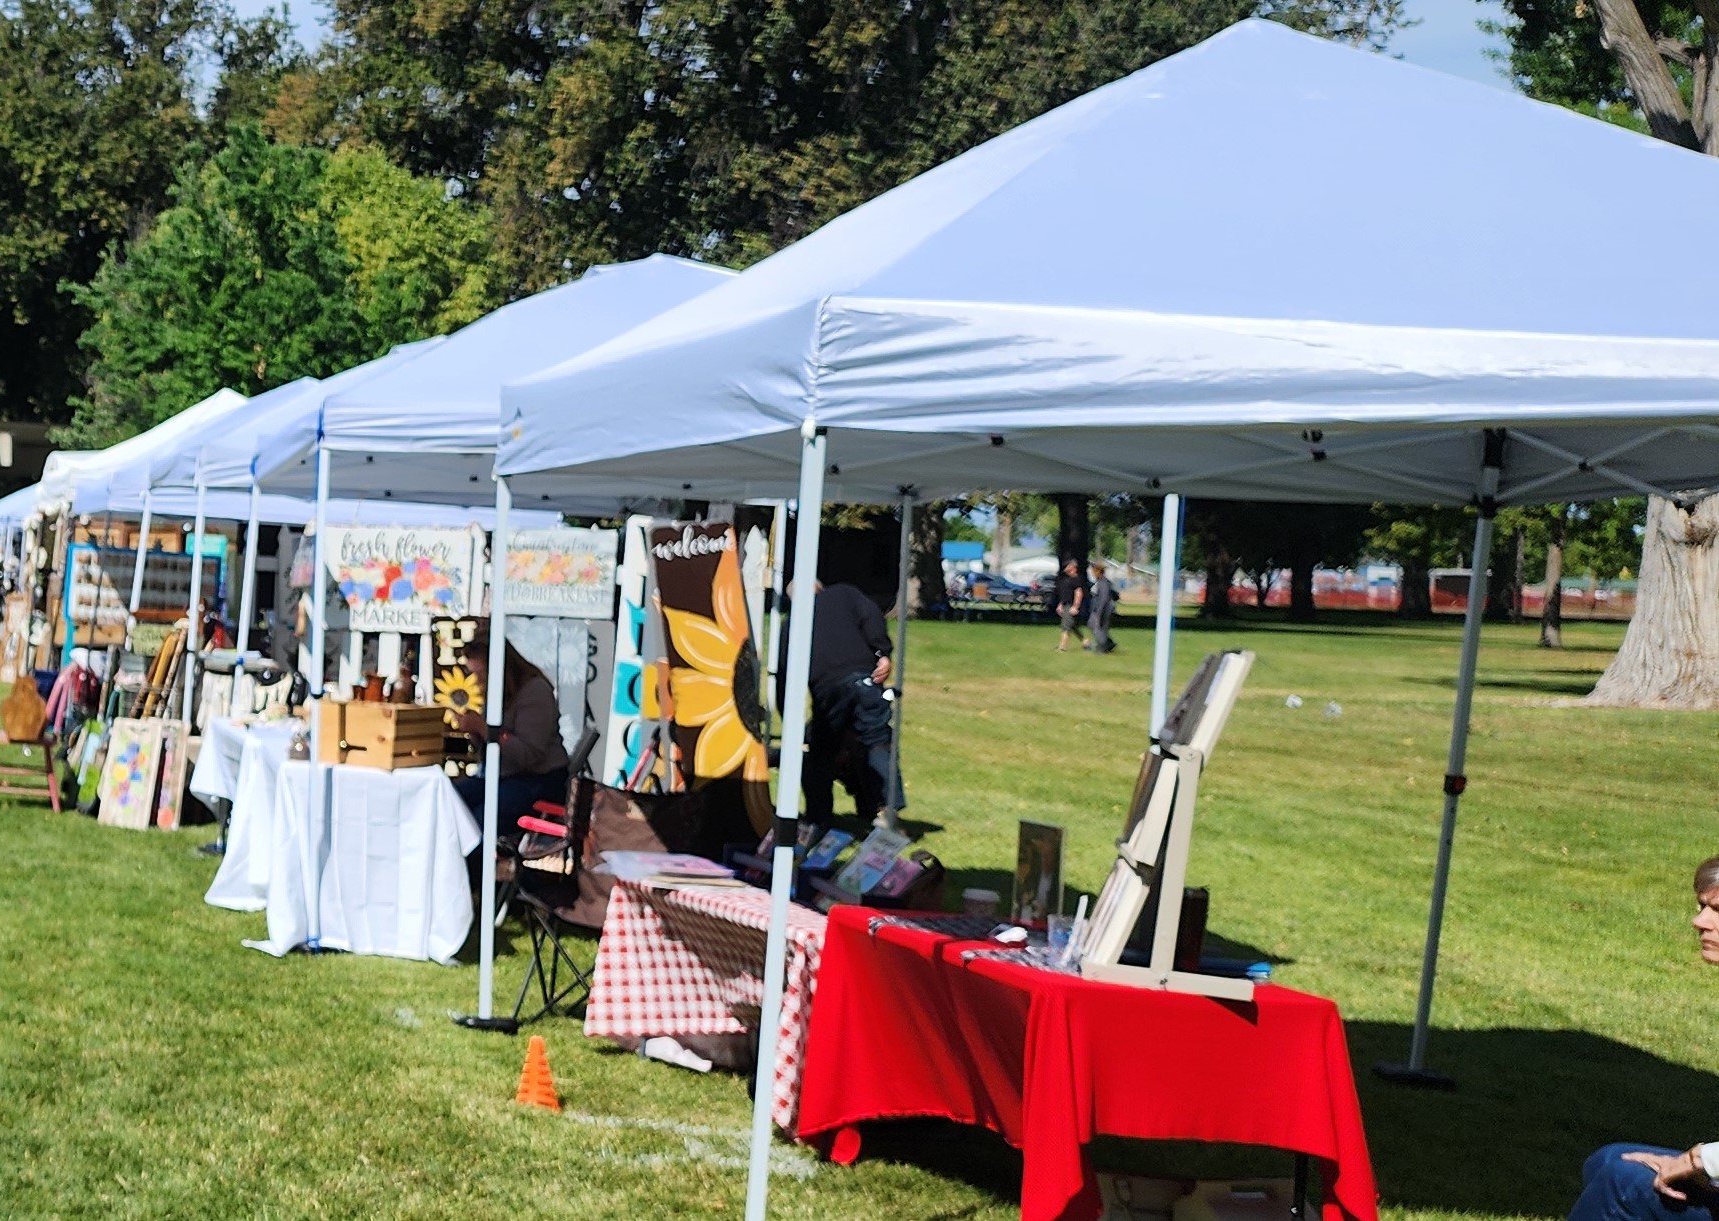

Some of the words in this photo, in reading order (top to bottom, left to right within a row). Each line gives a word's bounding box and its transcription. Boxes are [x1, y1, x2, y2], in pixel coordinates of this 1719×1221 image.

[341, 530, 388, 560] fresh
[396, 531, 451, 563] flower
[651, 524, 737, 560] welcome
